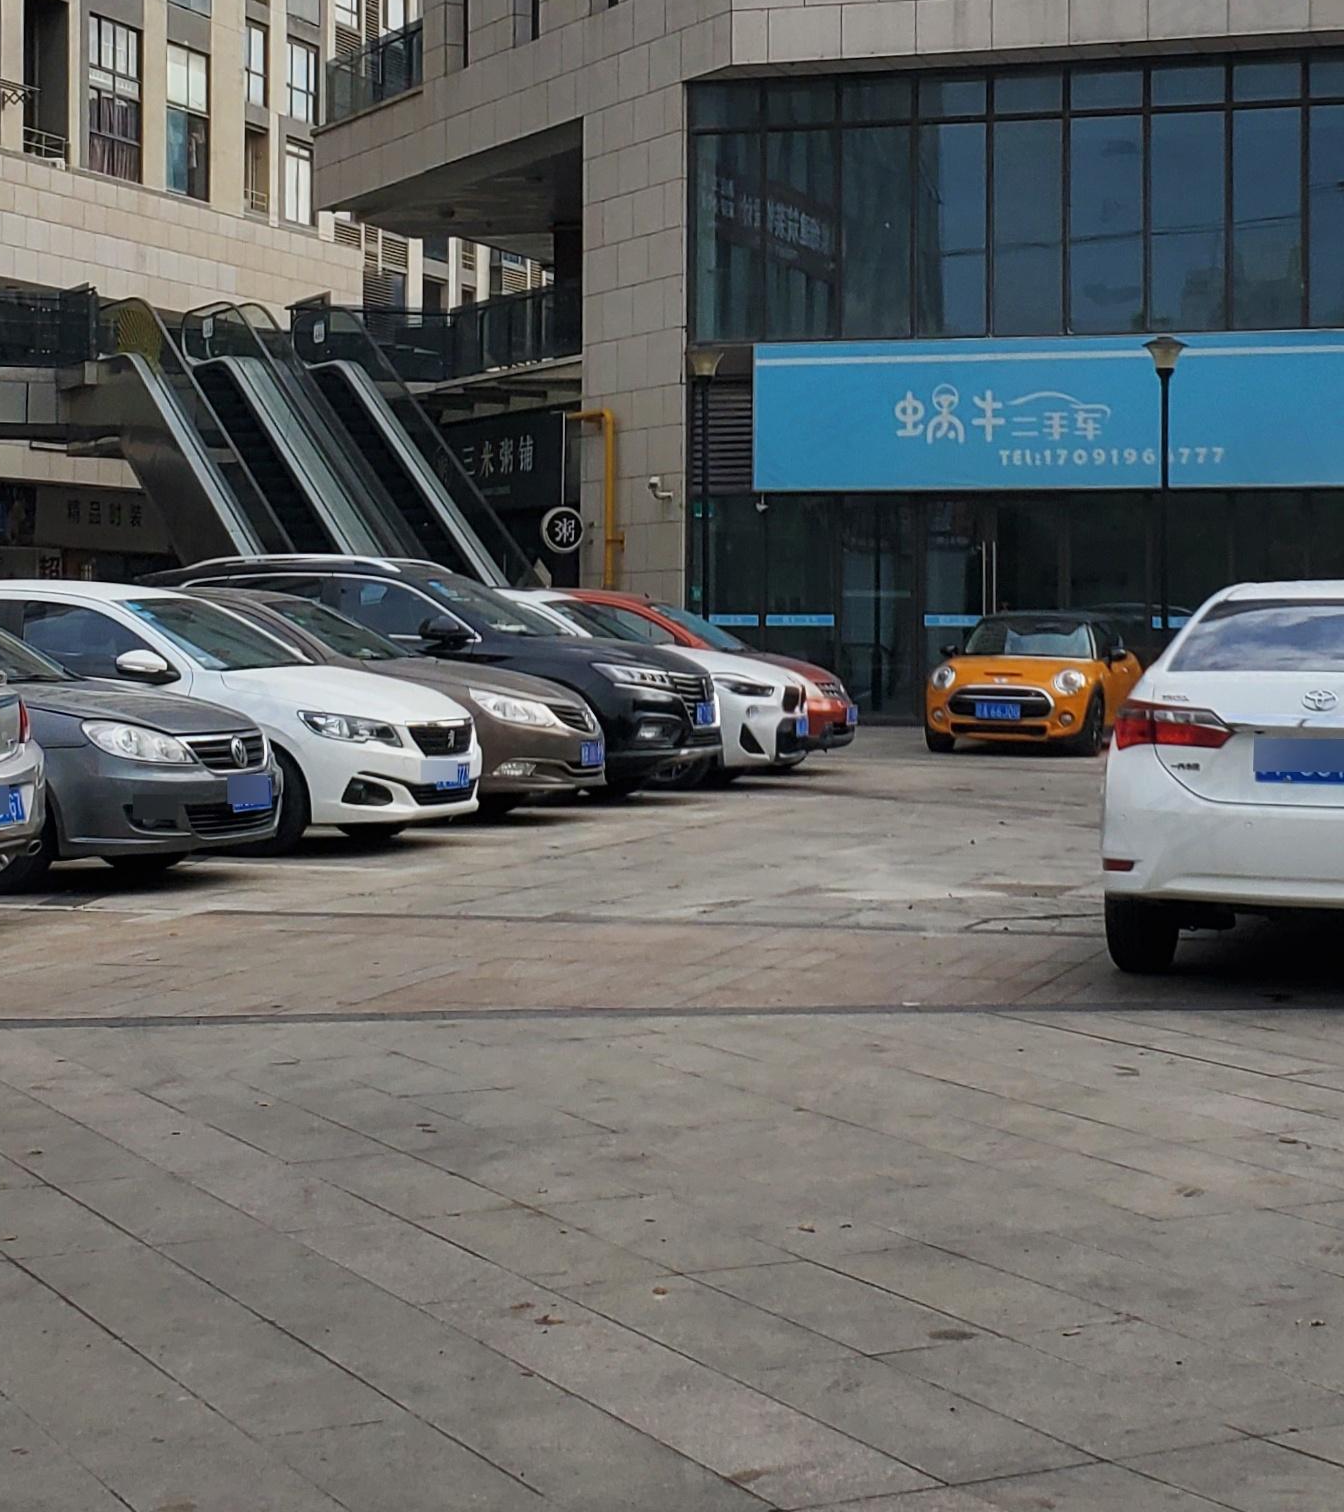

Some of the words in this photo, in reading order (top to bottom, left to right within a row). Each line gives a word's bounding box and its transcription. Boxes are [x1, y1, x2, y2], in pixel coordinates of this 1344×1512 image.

[895, 384, 1005, 444] 蜗牛
[1011, 410, 1104, 442] 二手车
[462, 435, 534, 477] 三米粥铺
[999, 447, 1225, 466] TEL:1709196777
[555, 518, 575, 543] 粥
